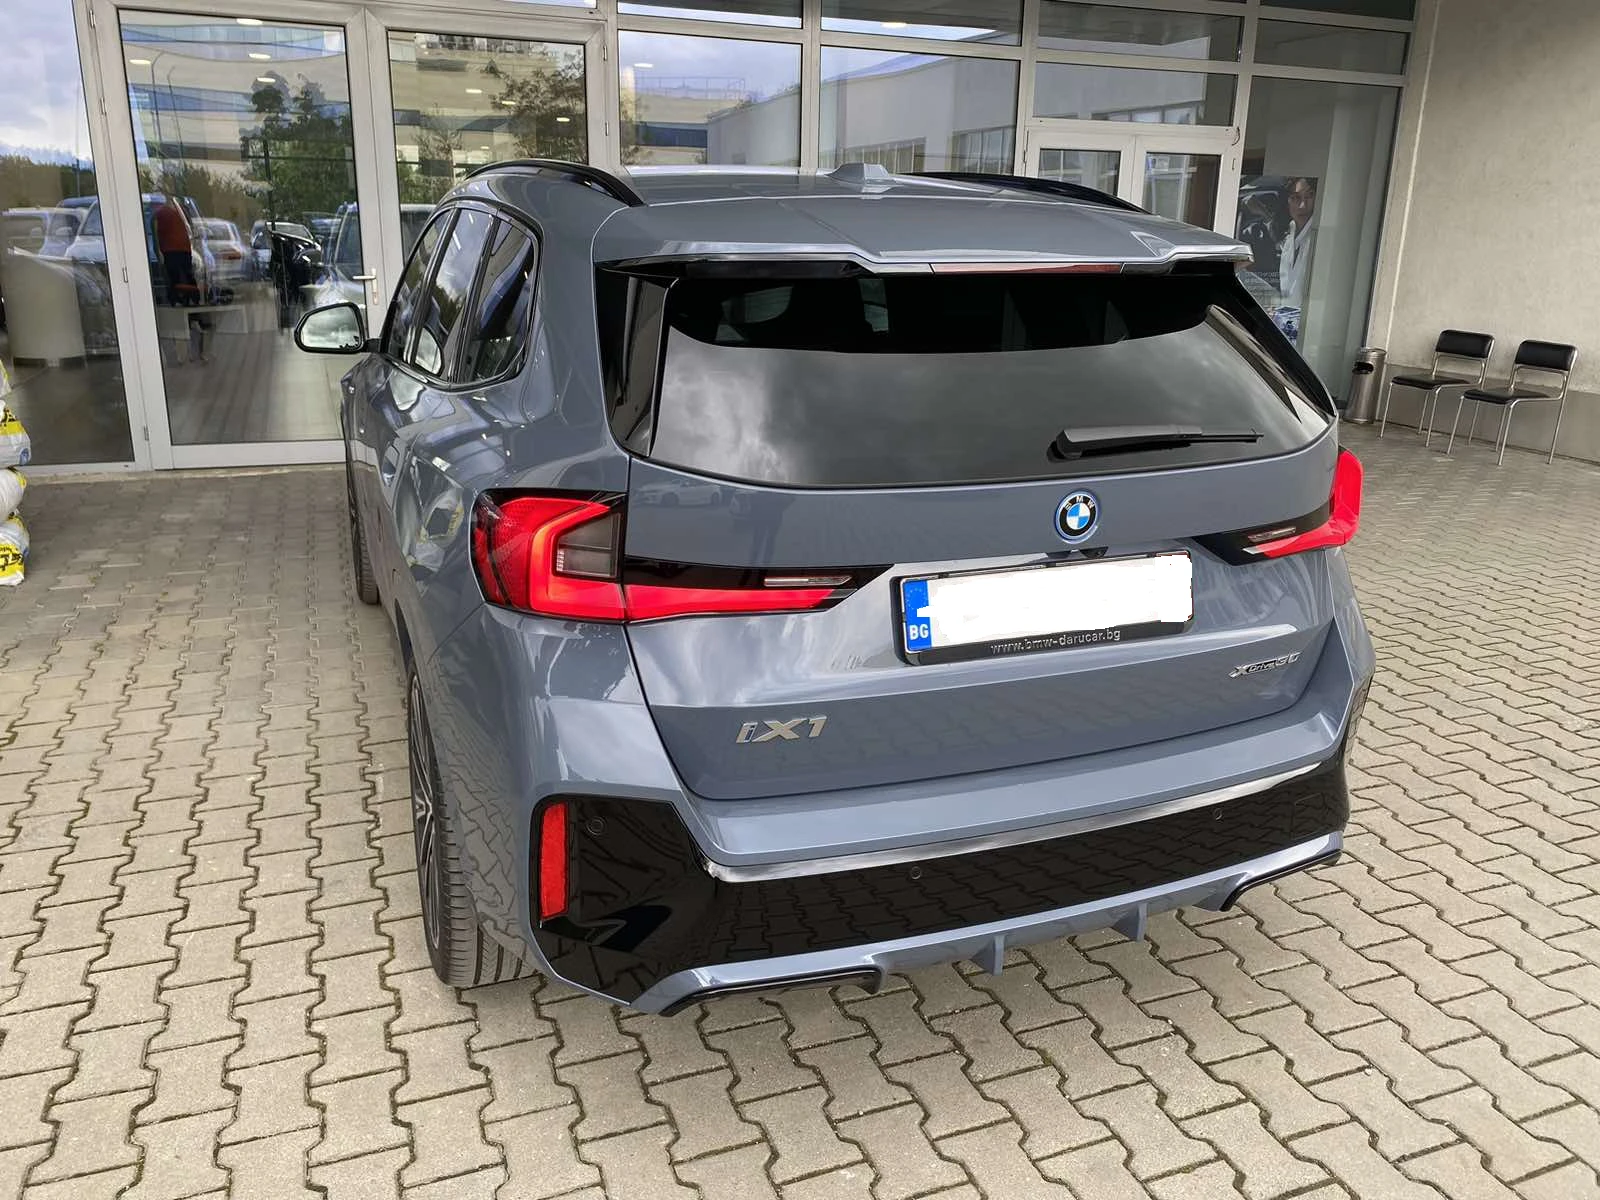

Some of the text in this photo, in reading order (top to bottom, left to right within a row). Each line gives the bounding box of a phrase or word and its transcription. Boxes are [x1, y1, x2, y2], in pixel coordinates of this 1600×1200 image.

[1064, 495, 1095, 510] BMW
[909, 623, 929, 640] BG
[990, 629, 1121, 655] www.bmw-darucar.bg
[736, 716, 827, 743] iX1
